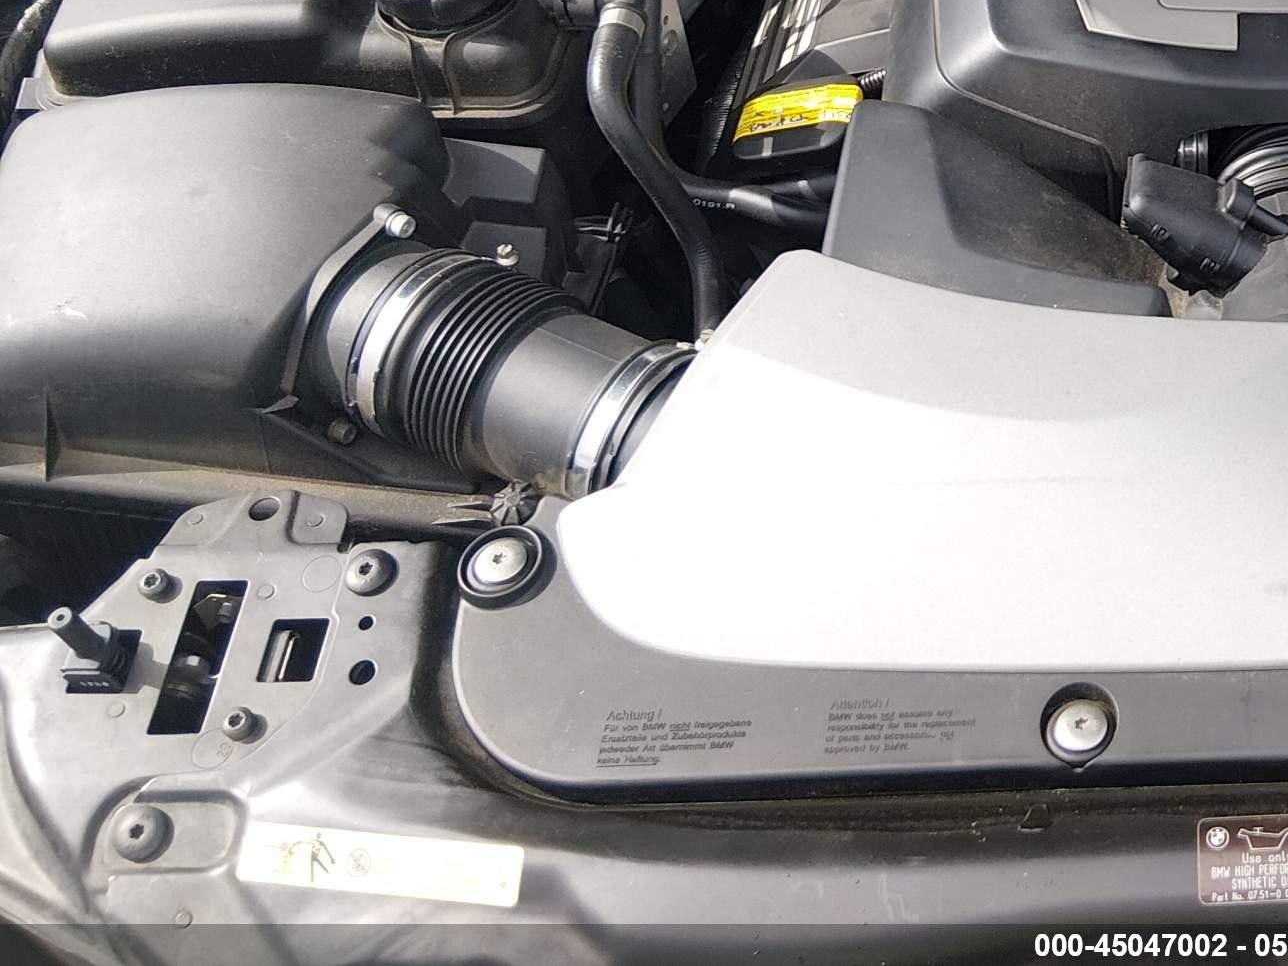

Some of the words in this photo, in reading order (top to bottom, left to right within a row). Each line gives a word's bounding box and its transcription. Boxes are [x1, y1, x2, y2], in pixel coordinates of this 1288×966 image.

[606, 710, 655, 722] Achtung
[1241, 852, 1262, 864] Use
[1211, 866, 1231, 879] BMW
[1234, 865, 1255, 877] HIGH
[1231, 876, 1277, 890] SYNTHETIC
[1211, 892, 1228, 902] Part
[1232, 891, 1244, 901] No.
